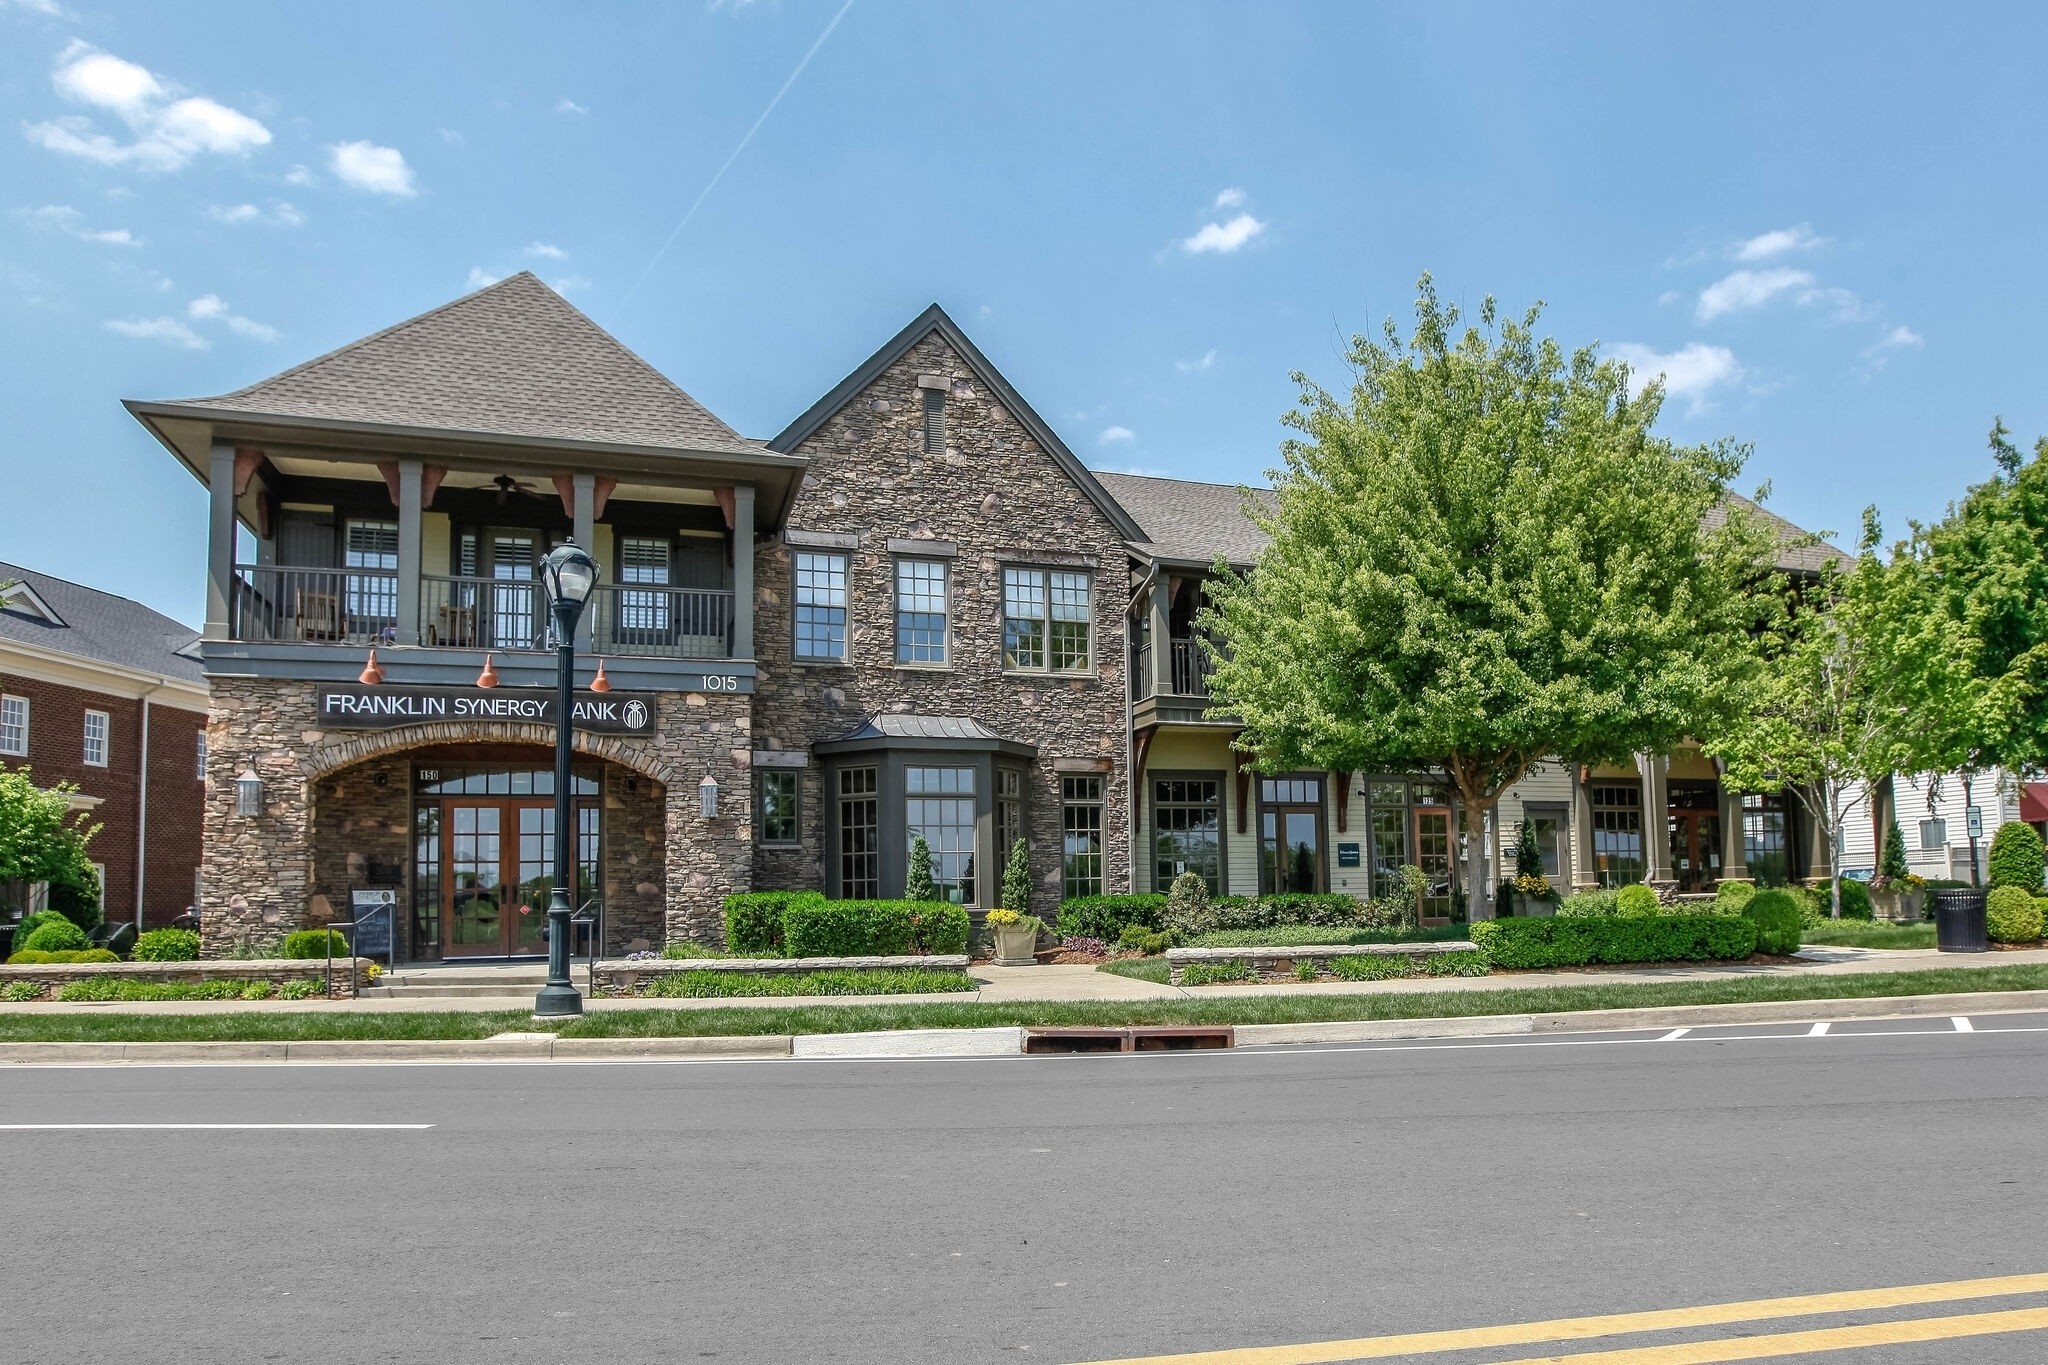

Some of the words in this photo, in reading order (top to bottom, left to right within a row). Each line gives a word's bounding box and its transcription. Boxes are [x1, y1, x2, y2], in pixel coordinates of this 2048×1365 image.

[702, 675, 737, 690] 1015
[326, 694, 445, 715] FRANKLIN
[454, 698, 548, 718] SYNERGY
[571, 702, 617, 721] ANK
[421, 770, 438, 780] 150
